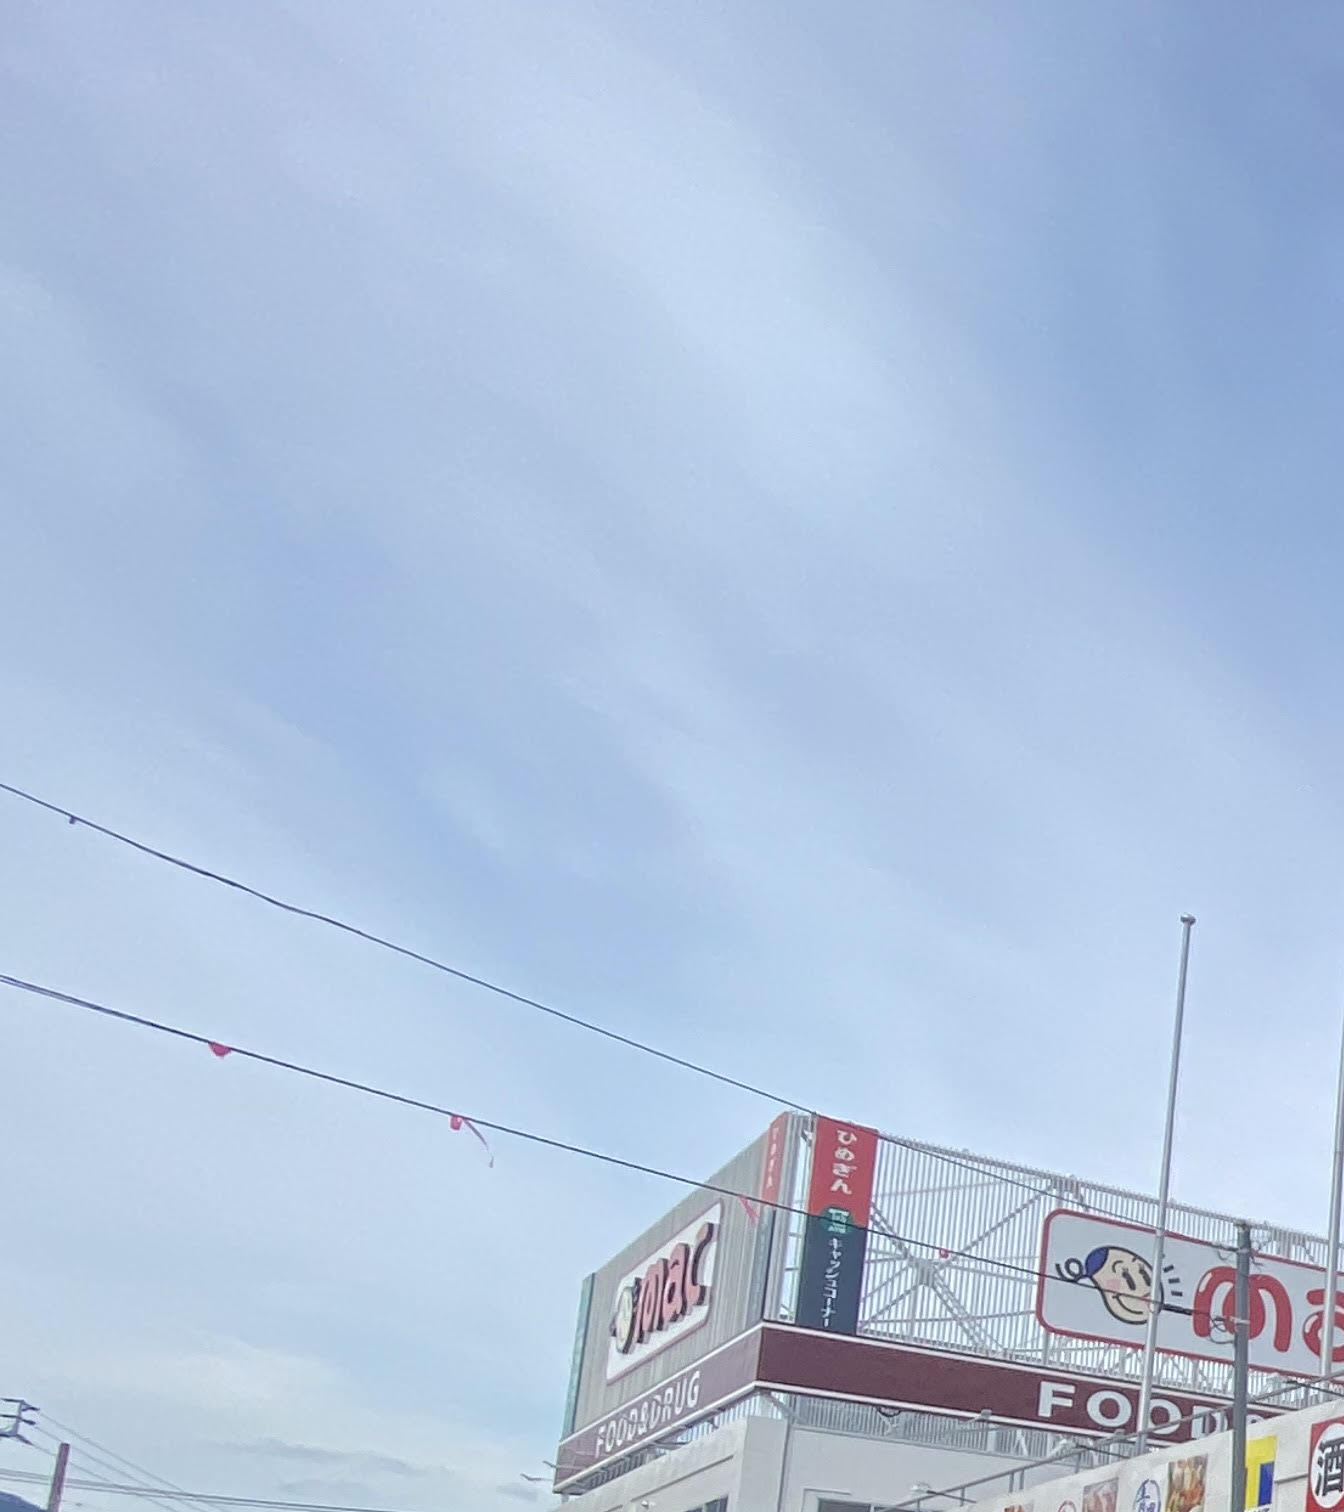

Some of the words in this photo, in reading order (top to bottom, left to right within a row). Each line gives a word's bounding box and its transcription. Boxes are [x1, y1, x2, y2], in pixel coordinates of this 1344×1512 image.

[831, 1129, 857, 1195] ひめぎん
[633, 1222, 715, 1344] mac
